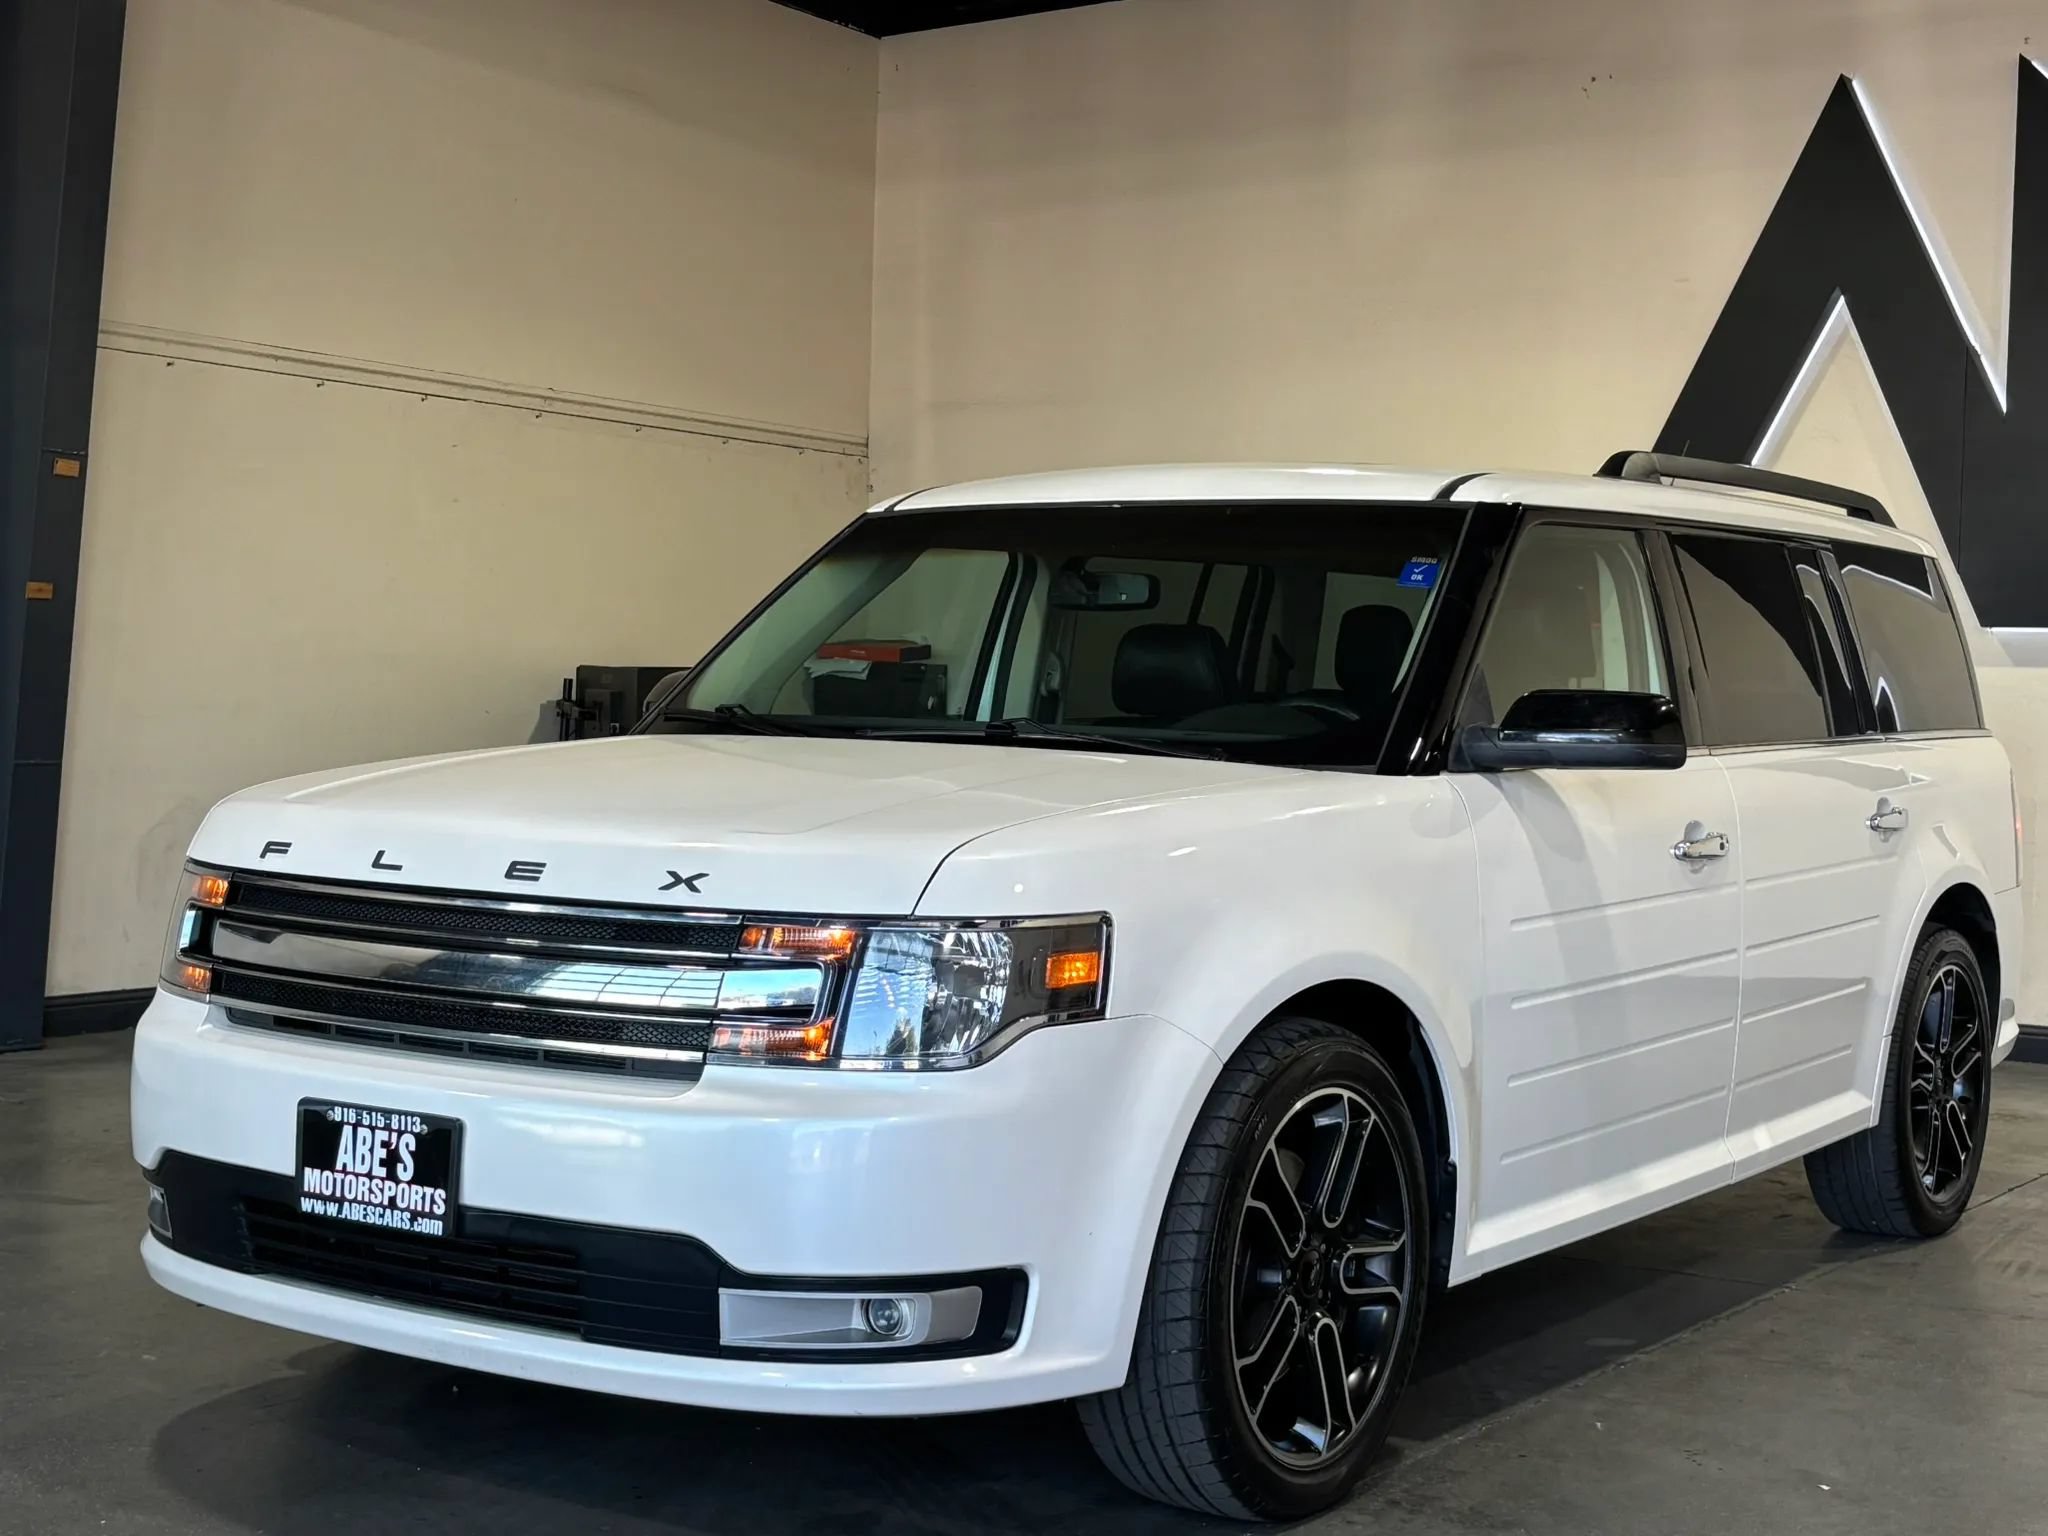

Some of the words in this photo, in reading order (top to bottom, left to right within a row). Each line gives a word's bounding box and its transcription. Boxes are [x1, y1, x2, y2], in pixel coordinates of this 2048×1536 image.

[259, 840, 709, 894] FLEX
[333, 1106, 421, 1133] 916-515-8113
[335, 1124, 416, 1182] ABE'S
[303, 1166, 447, 1216] MOTORSPORTS
